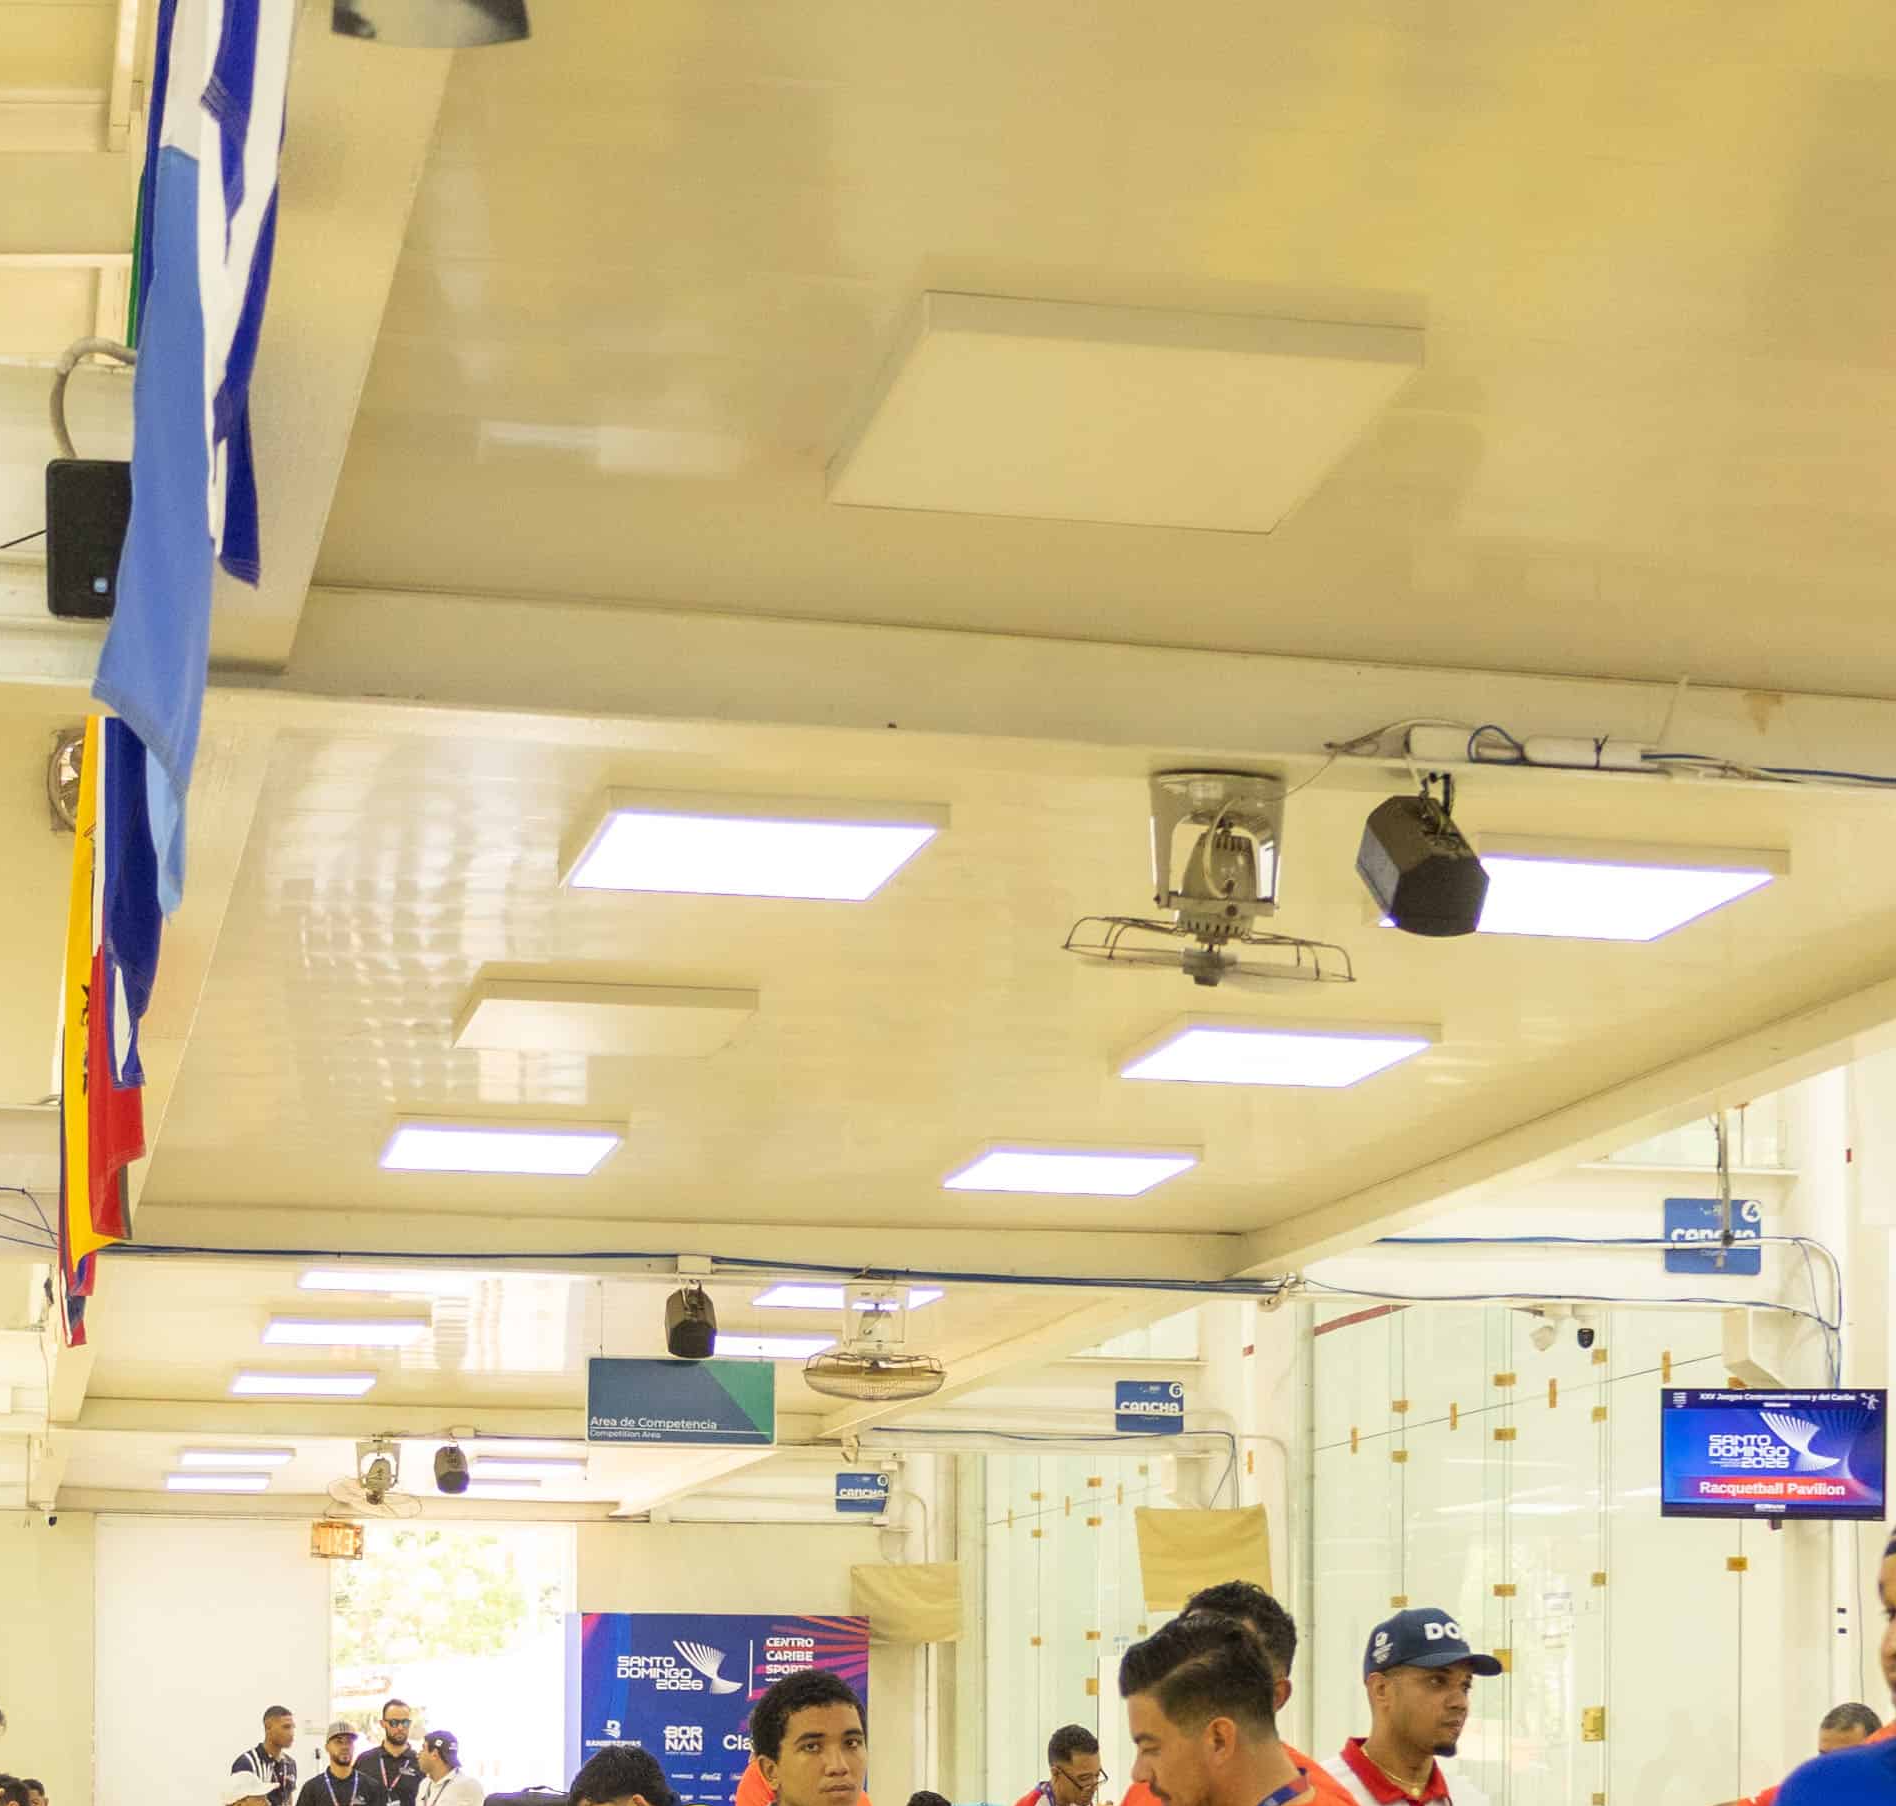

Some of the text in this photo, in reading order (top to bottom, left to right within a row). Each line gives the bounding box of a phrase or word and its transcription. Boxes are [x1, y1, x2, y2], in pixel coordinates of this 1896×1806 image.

[1120, 1401, 1180, 1413] CANCHA
[620, 1416, 635, 1427] de
[637, 1417, 717, 1431] Competencia
[641, 1430, 661, 1439] Area
[1708, 1434, 1771, 1447] SANTO
[1709, 1446, 1790, 1457] DOMINGO
[1741, 1457, 1789, 1469] 2026
[1700, 1481, 1846, 1496] Racquetball Pavilion
[1424, 1622, 1462, 1640] DO
[766, 1637, 814, 1648] CENTRO
[617, 1656, 675, 1668] SANTO
[766, 1651, 814, 1662] CARIBE
[617, 1668, 692, 1679] DOMINGO
[655, 1680, 703, 1690] 2026
[722, 1735, 754, 1750] Cla
